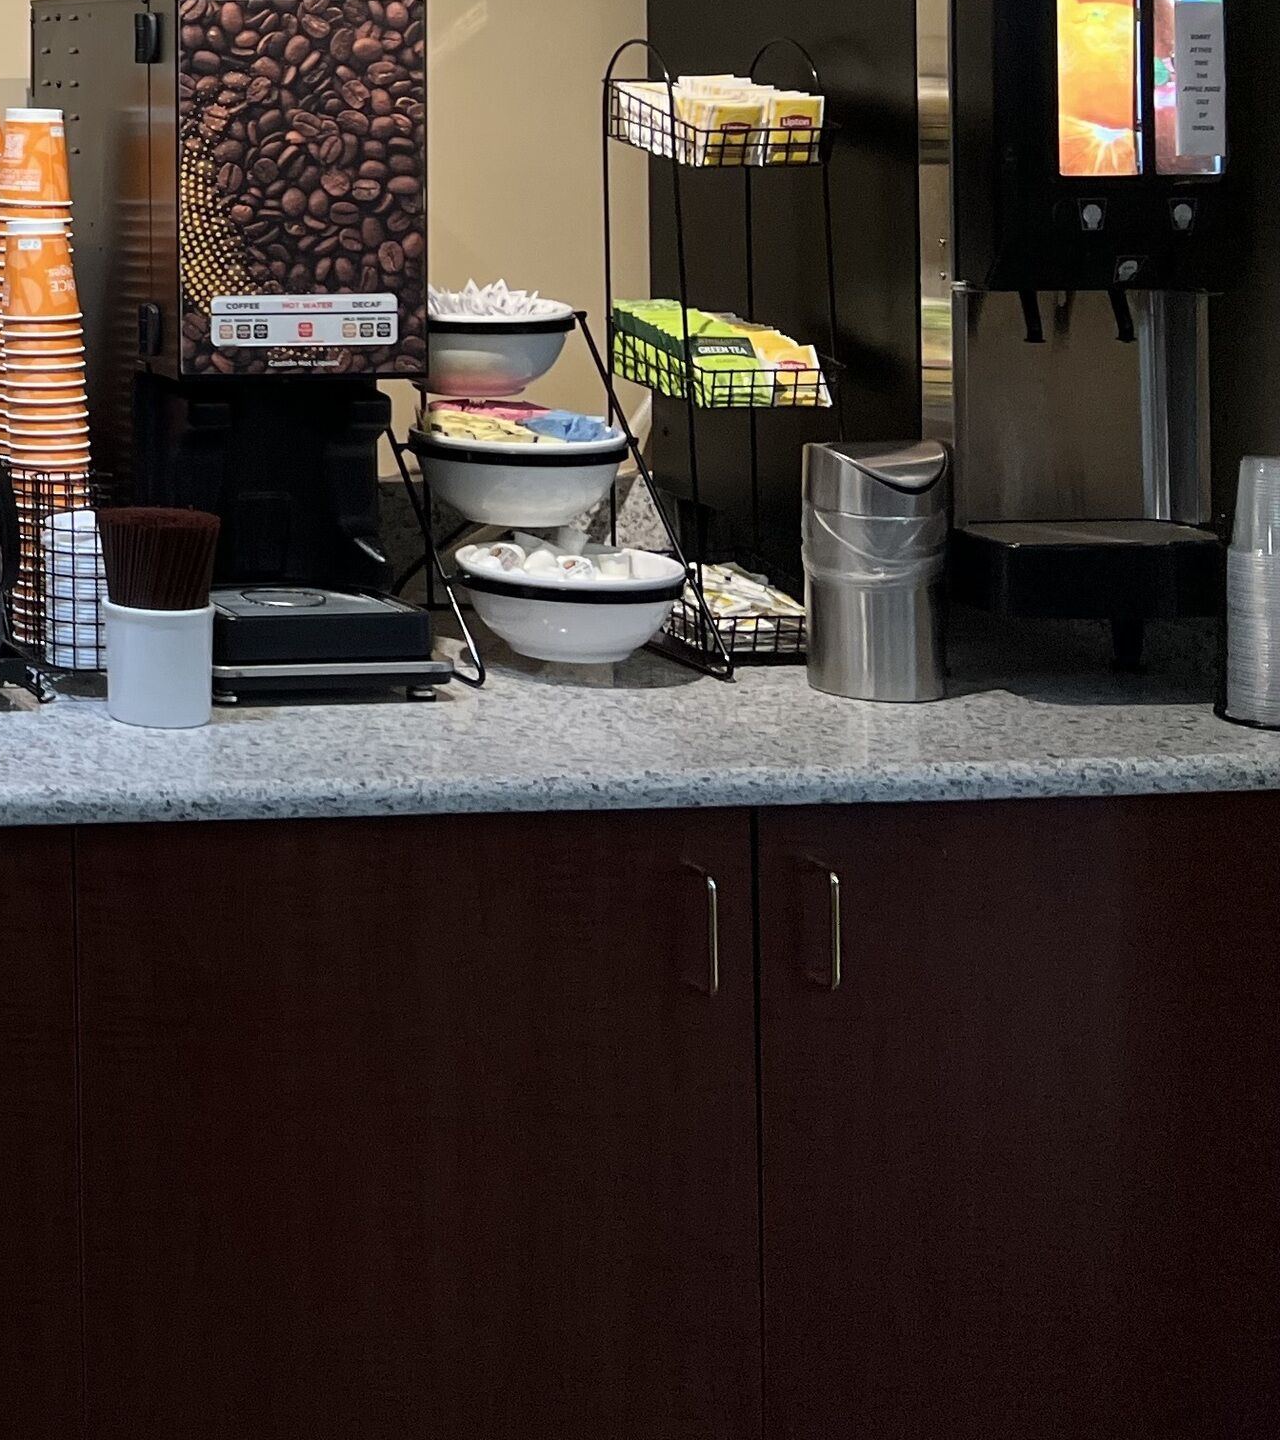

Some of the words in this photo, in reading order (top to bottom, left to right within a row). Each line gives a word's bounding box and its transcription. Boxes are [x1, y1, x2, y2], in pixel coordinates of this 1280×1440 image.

[782, 117, 811, 127] Lipton
[226, 302, 260, 311] COFFEE
[282, 302, 301, 310] HOT
[302, 302, 333, 310] WATER
[352, 301, 382, 309] DECAF
[698, 345, 729, 354] GREEN
[728, 345, 748, 355] TEA
